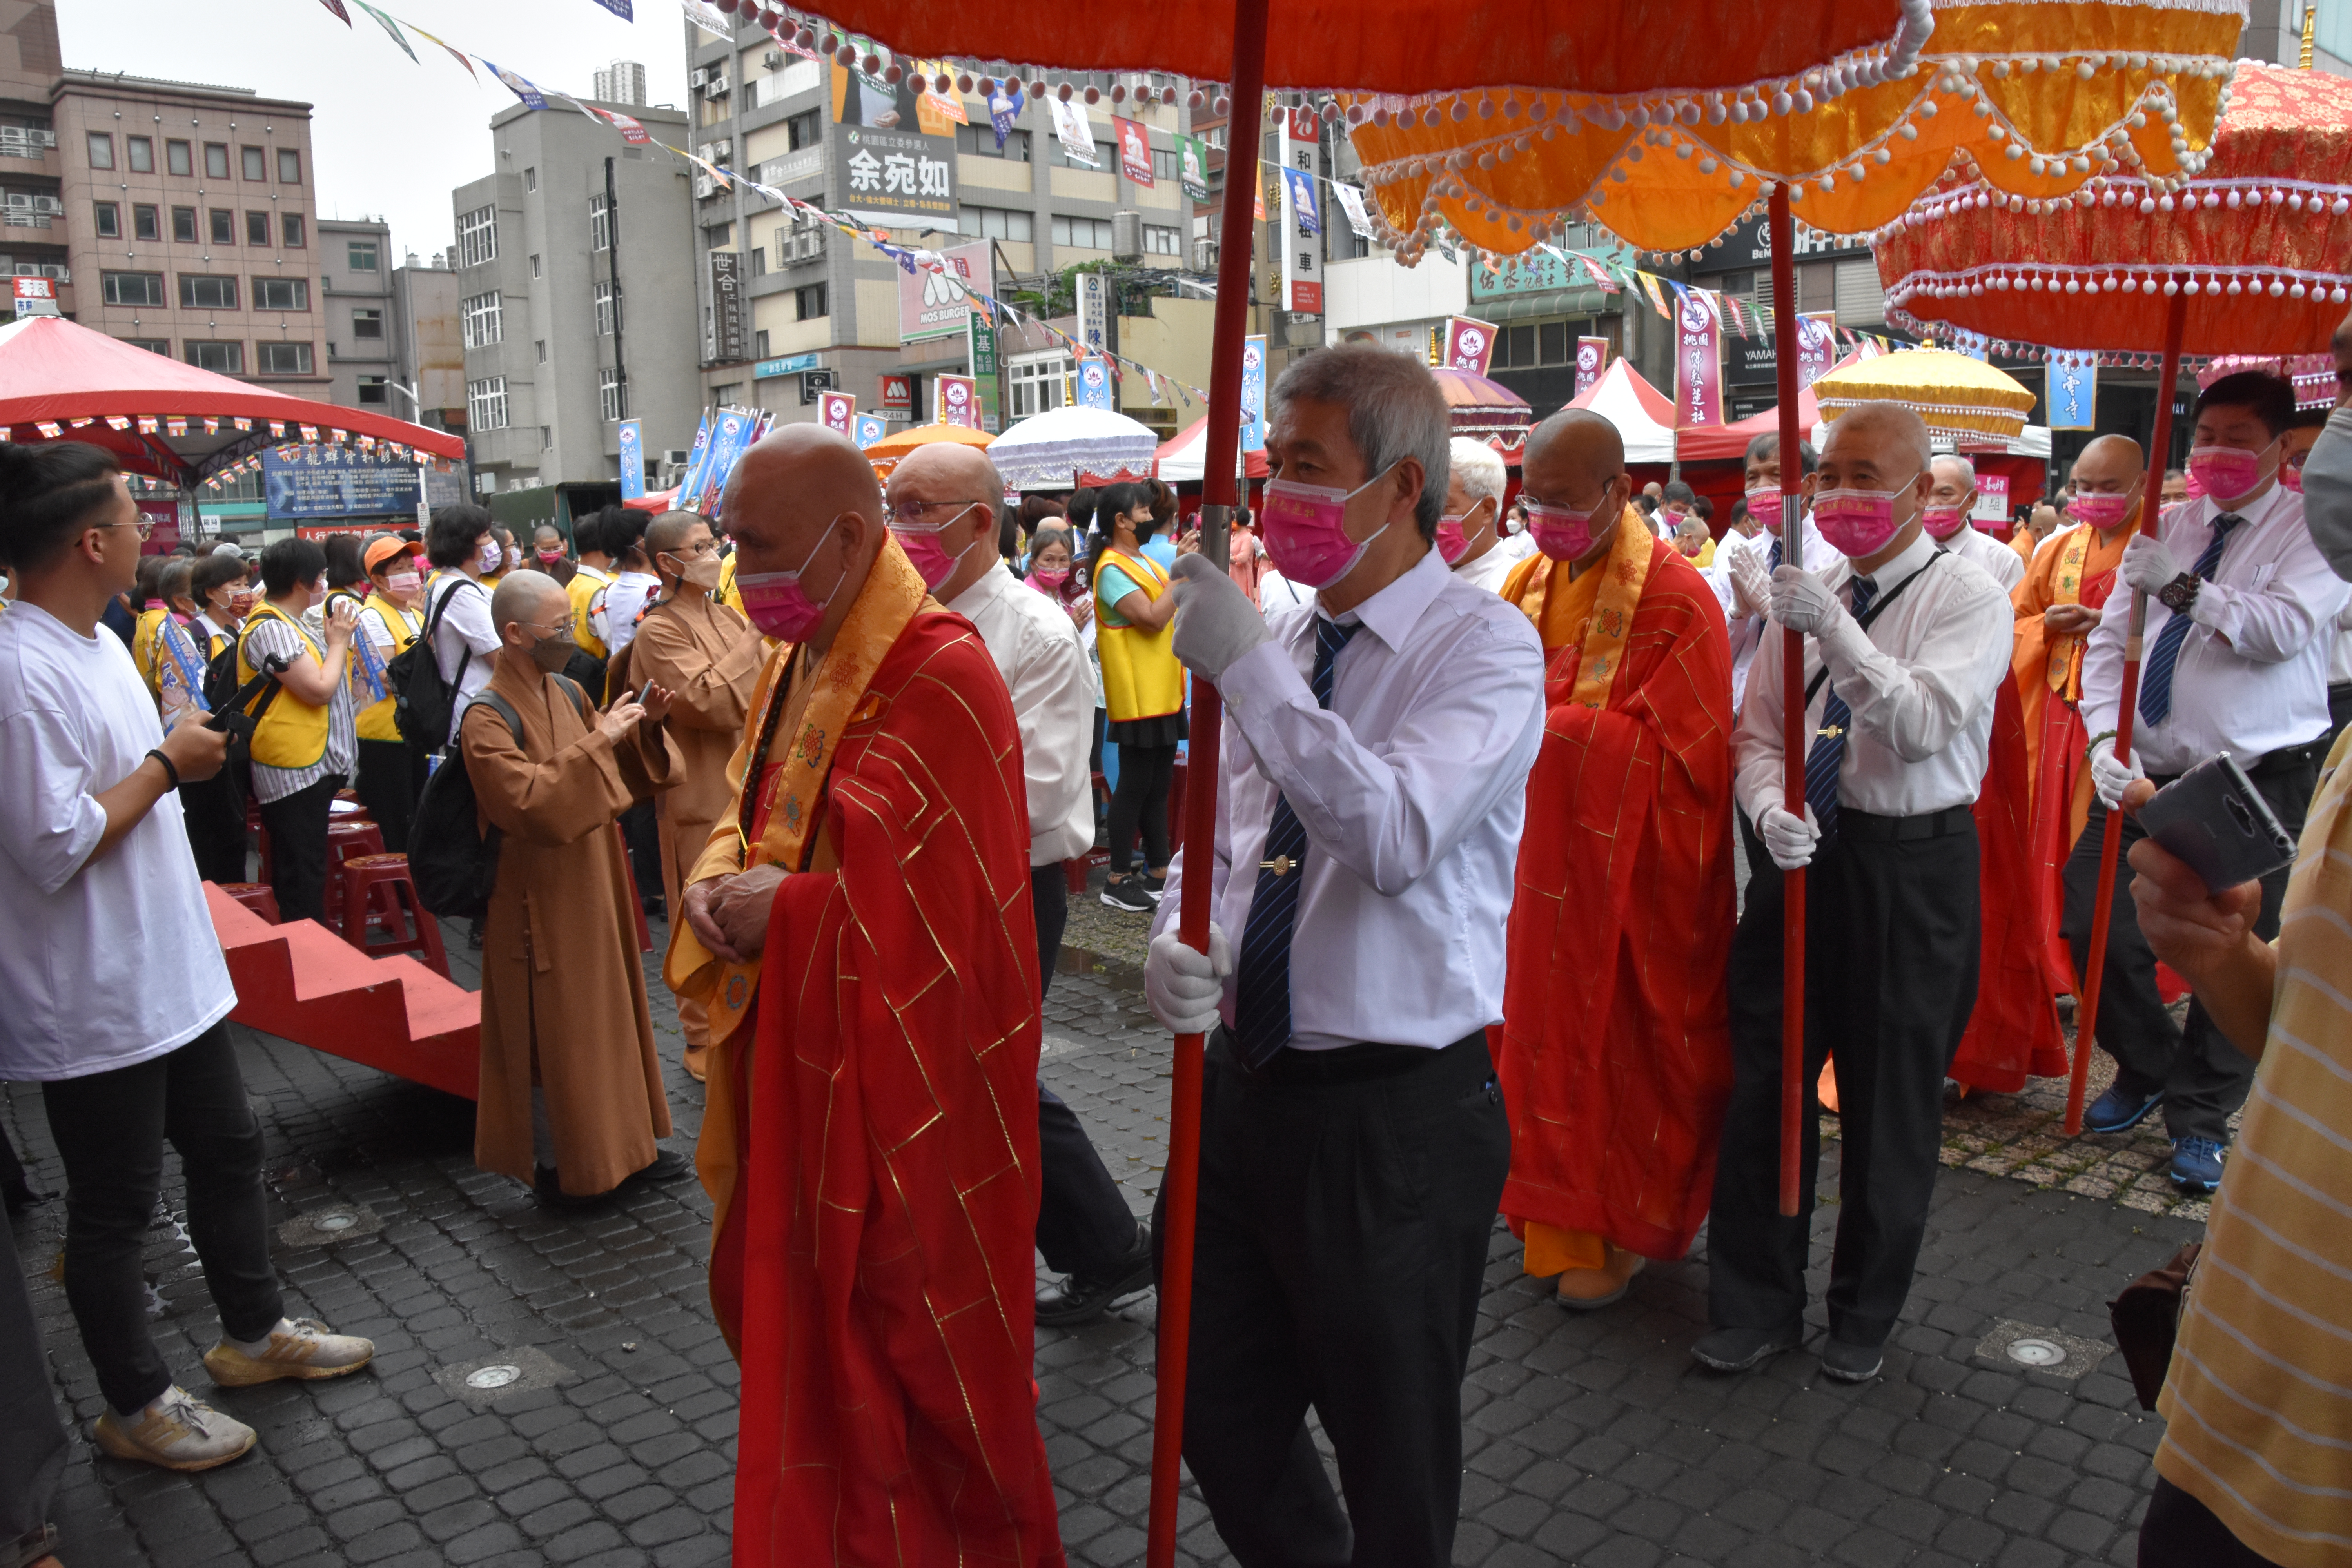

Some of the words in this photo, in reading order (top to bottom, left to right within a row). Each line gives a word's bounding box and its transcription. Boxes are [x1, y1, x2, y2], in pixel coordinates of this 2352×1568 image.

[848, 149, 949, 197] 余宛如
[19, 279, 51, 297] 租
[920, 312, 938, 325] MOS
[939, 305, 971, 321] BURGER
[1683, 332, 1709, 347] 桃園
[1455, 355, 1479, 372] 桃園
[1690, 347, 1706, 424] 佛教蓮社
[883, 412, 902, 420] 24H
[947, 404, 967, 416] 桃園
